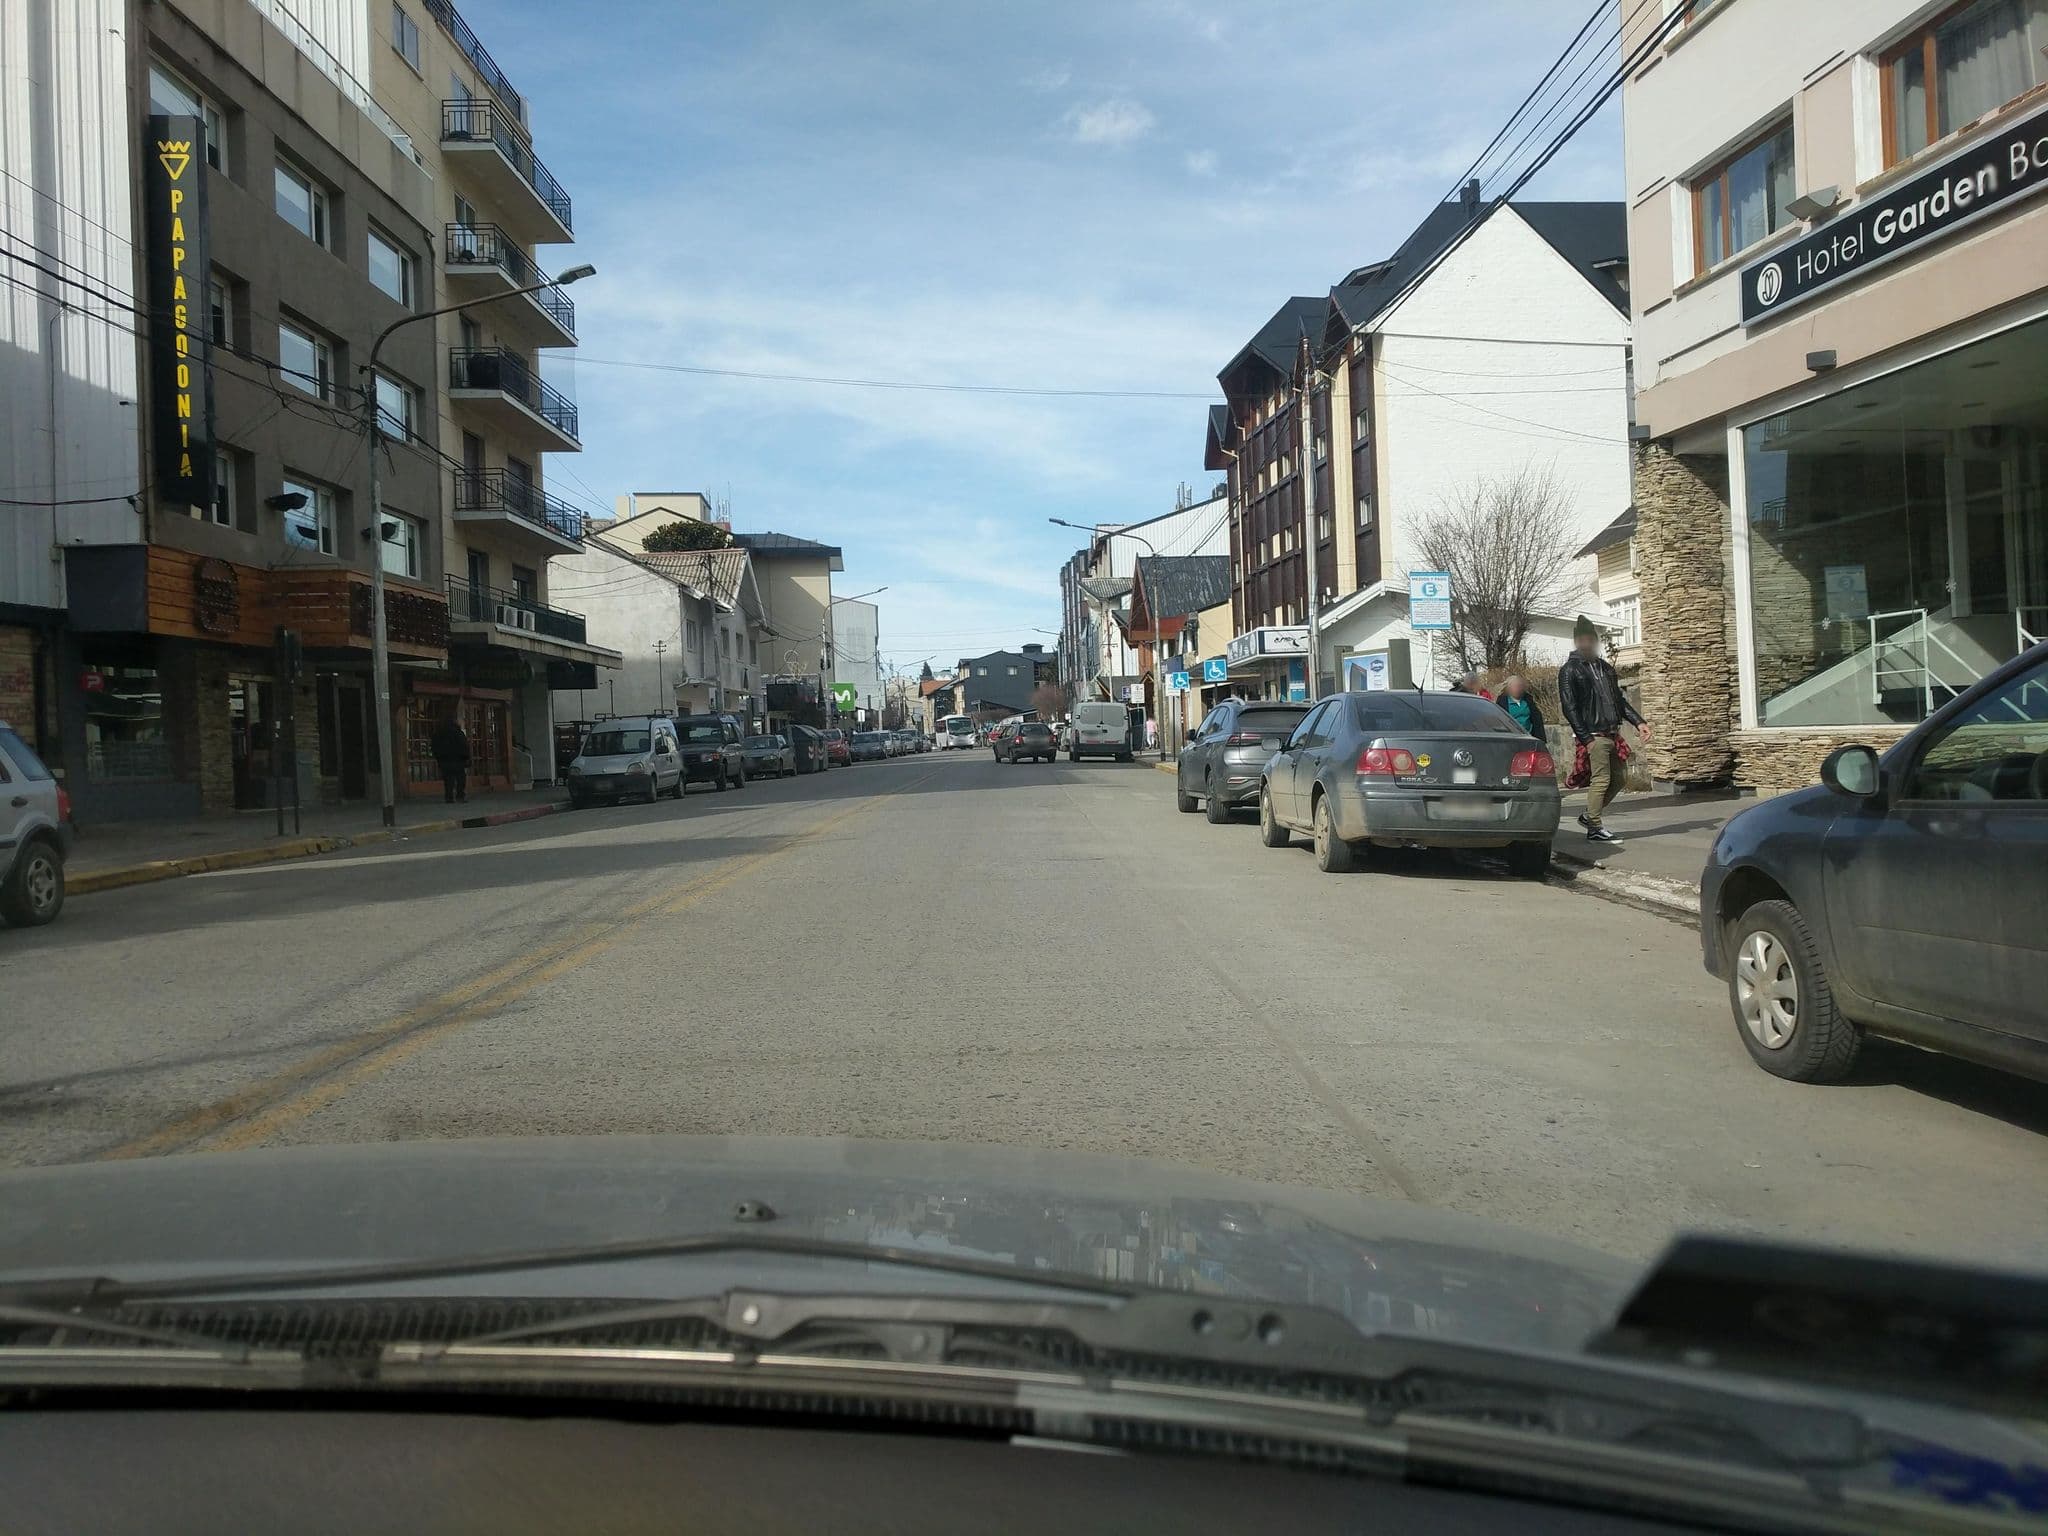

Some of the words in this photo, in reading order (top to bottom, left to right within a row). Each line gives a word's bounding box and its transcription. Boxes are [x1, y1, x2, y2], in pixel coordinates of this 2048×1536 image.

[1796, 222, 1863, 285] Hotel
[1872, 163, 1998, 245] Garden
[170, 189, 192, 477] PAPAGOONIA
[1425, 584, 1435, 596] E
